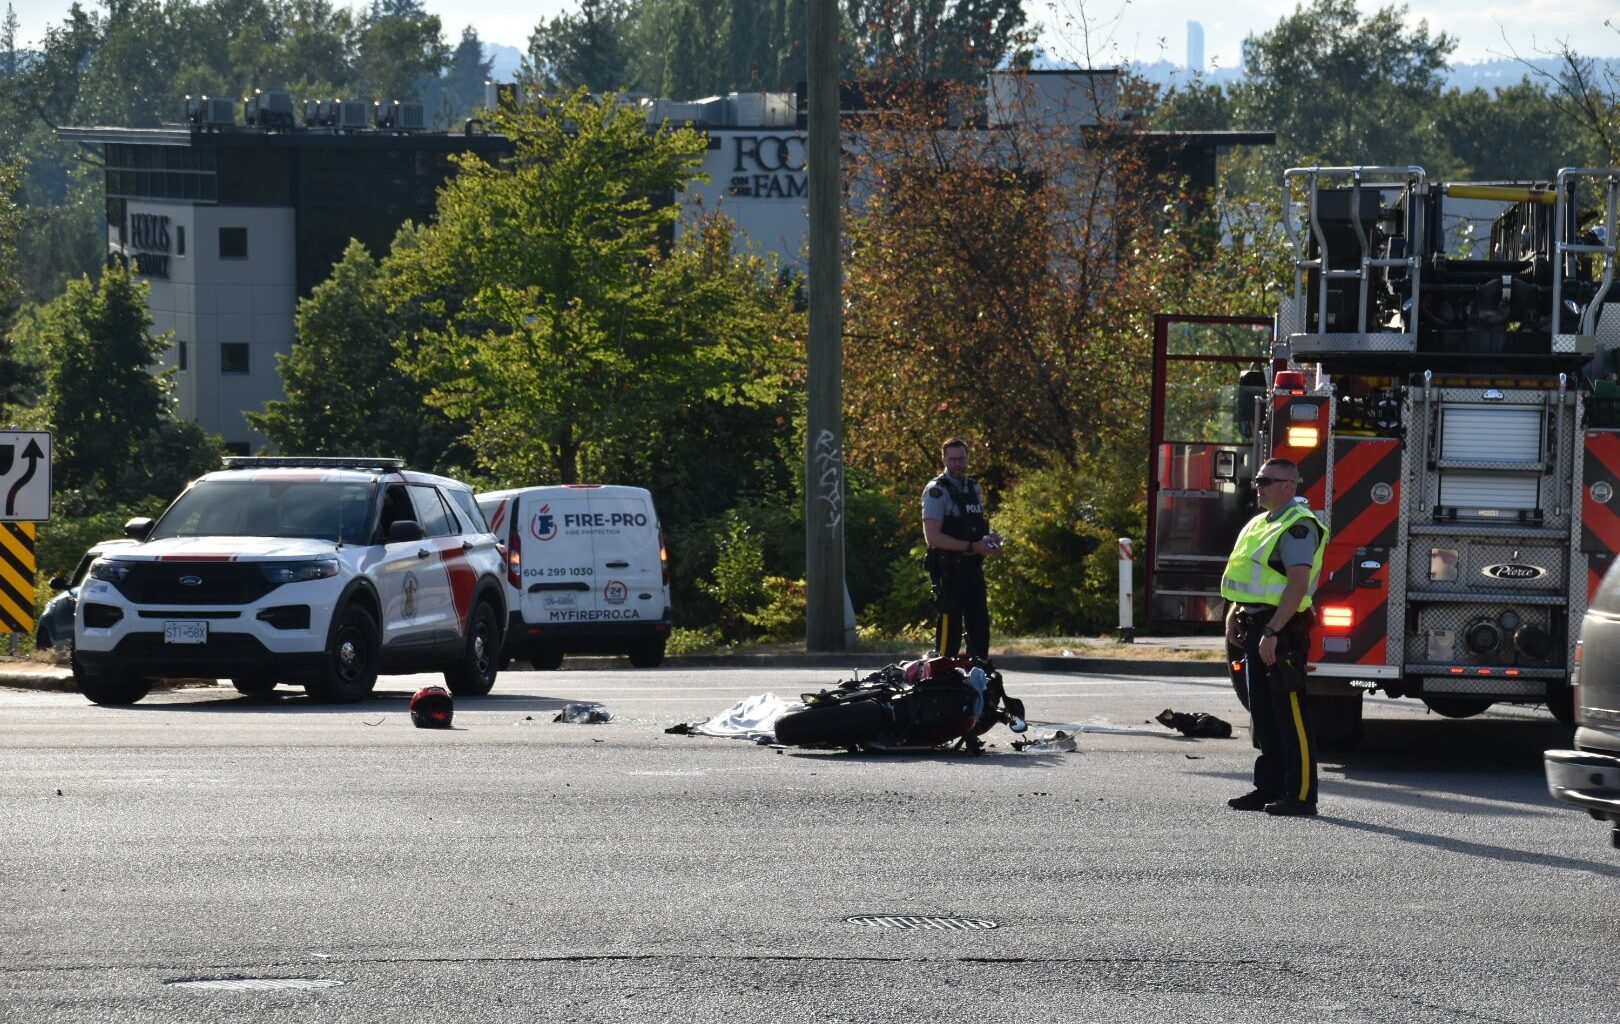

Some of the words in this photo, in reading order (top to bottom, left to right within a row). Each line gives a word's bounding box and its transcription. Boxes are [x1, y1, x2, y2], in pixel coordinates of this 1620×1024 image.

[732, 136, 808, 172] FOC
[753, 174, 808, 198] FAM
[564, 513, 647, 528] FIRE-PRO
[523, 568, 545, 577] 604
[547, 568, 567, 576] 299
[570, 567, 593, 576] 1030
[1496, 565, 1533, 577] Pierce
[549, 609, 640, 621] MYFIREPRO.CA
